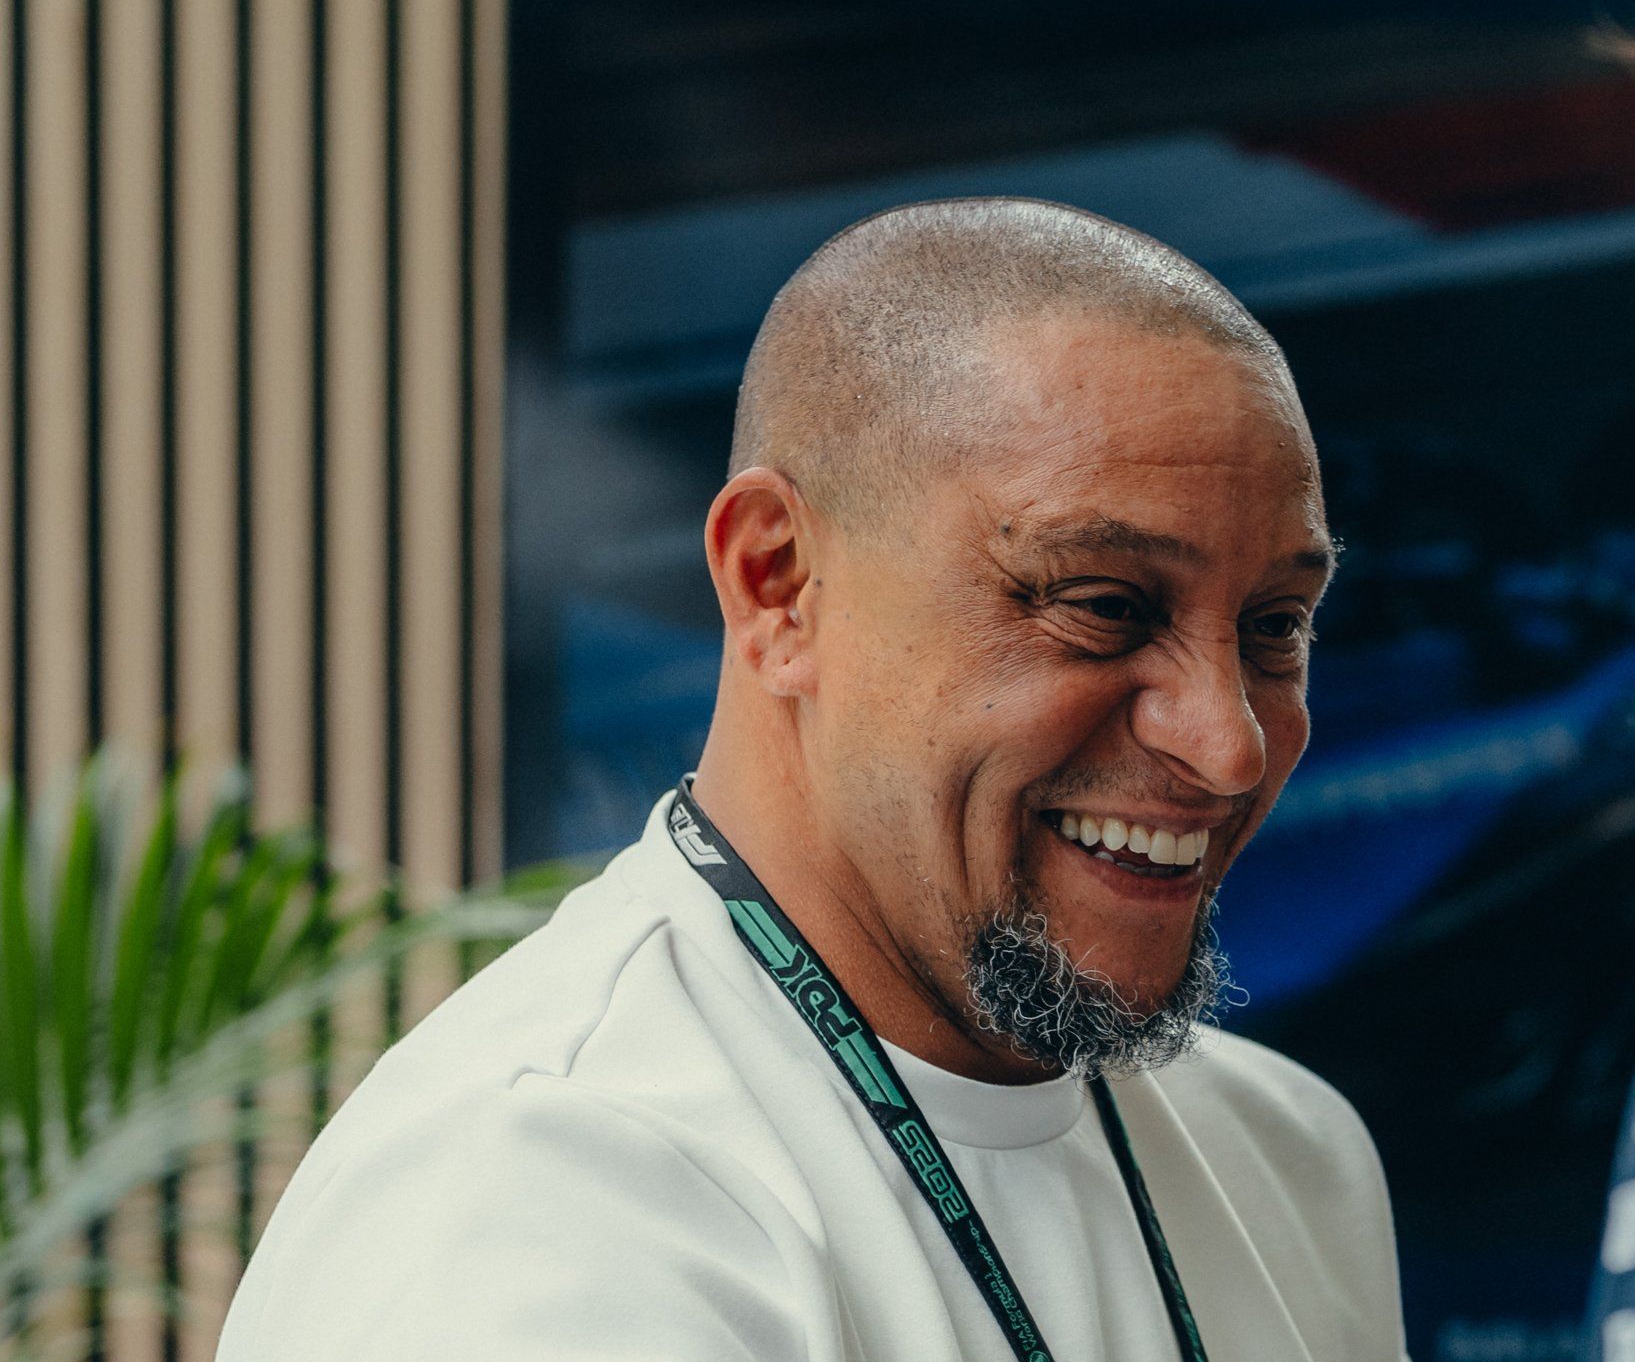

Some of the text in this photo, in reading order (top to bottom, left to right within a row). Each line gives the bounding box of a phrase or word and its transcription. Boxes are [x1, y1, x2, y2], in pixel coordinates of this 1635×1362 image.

[768, 943, 862, 1051] PDK
[891, 1120, 969, 1224] 2025
[988, 1279, 1020, 1330] Formula
